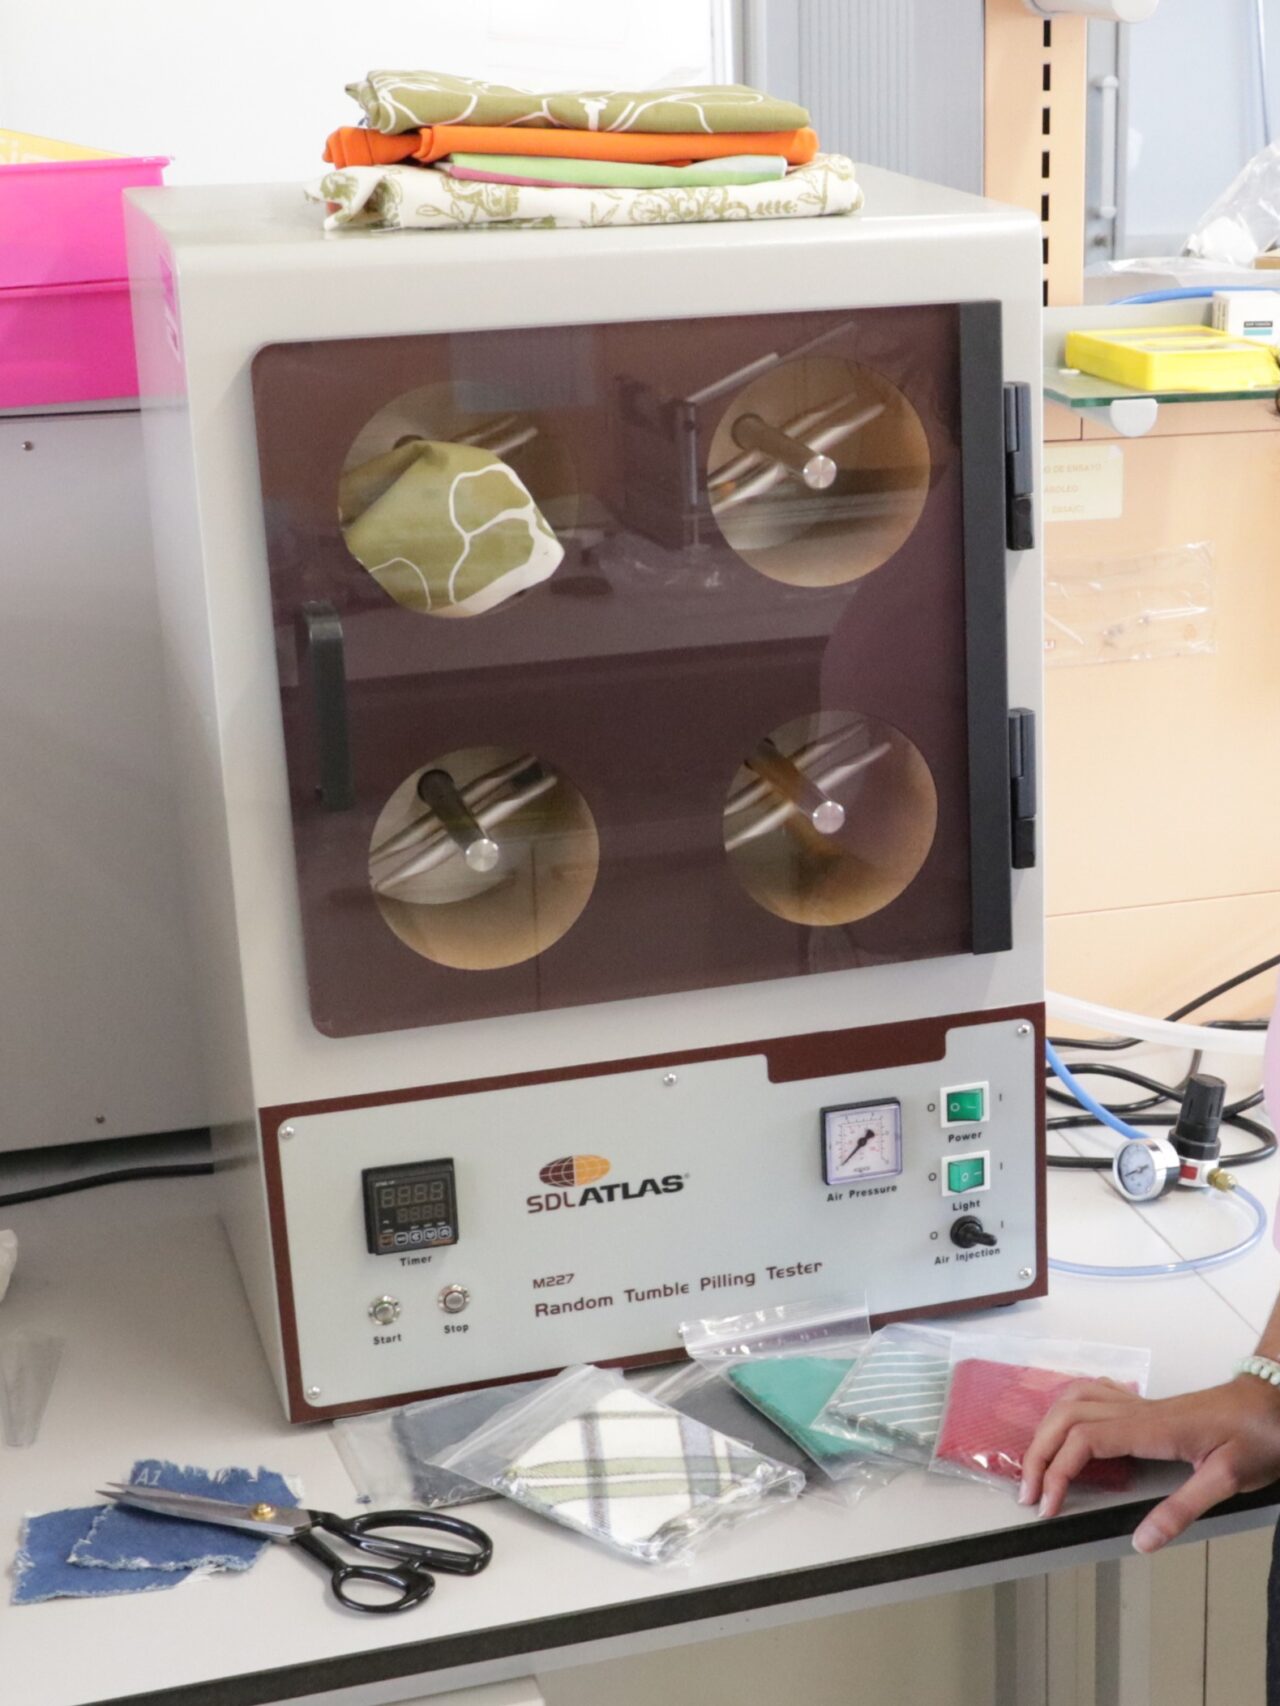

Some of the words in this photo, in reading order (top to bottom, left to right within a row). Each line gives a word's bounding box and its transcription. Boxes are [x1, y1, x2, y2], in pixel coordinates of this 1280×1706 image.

[948, 1131, 982, 1143] Power
[827, 1192, 844, 1202] Air
[849, 1184, 898, 1199] Pressure
[952, 1200, 981, 1212] Light
[399, 1255, 433, 1267] Timer
[934, 1255, 950, 1266] Air
[532, 1272, 575, 1290] M227
[535, 1293, 614, 1318] Random
[624, 1281, 690, 1304] Tumble
[700, 1271, 756, 1292] Pilling
[766, 1261, 823, 1281] Tester
[444, 1323, 469, 1335] Stop
[373, 1333, 402, 1346] Start
